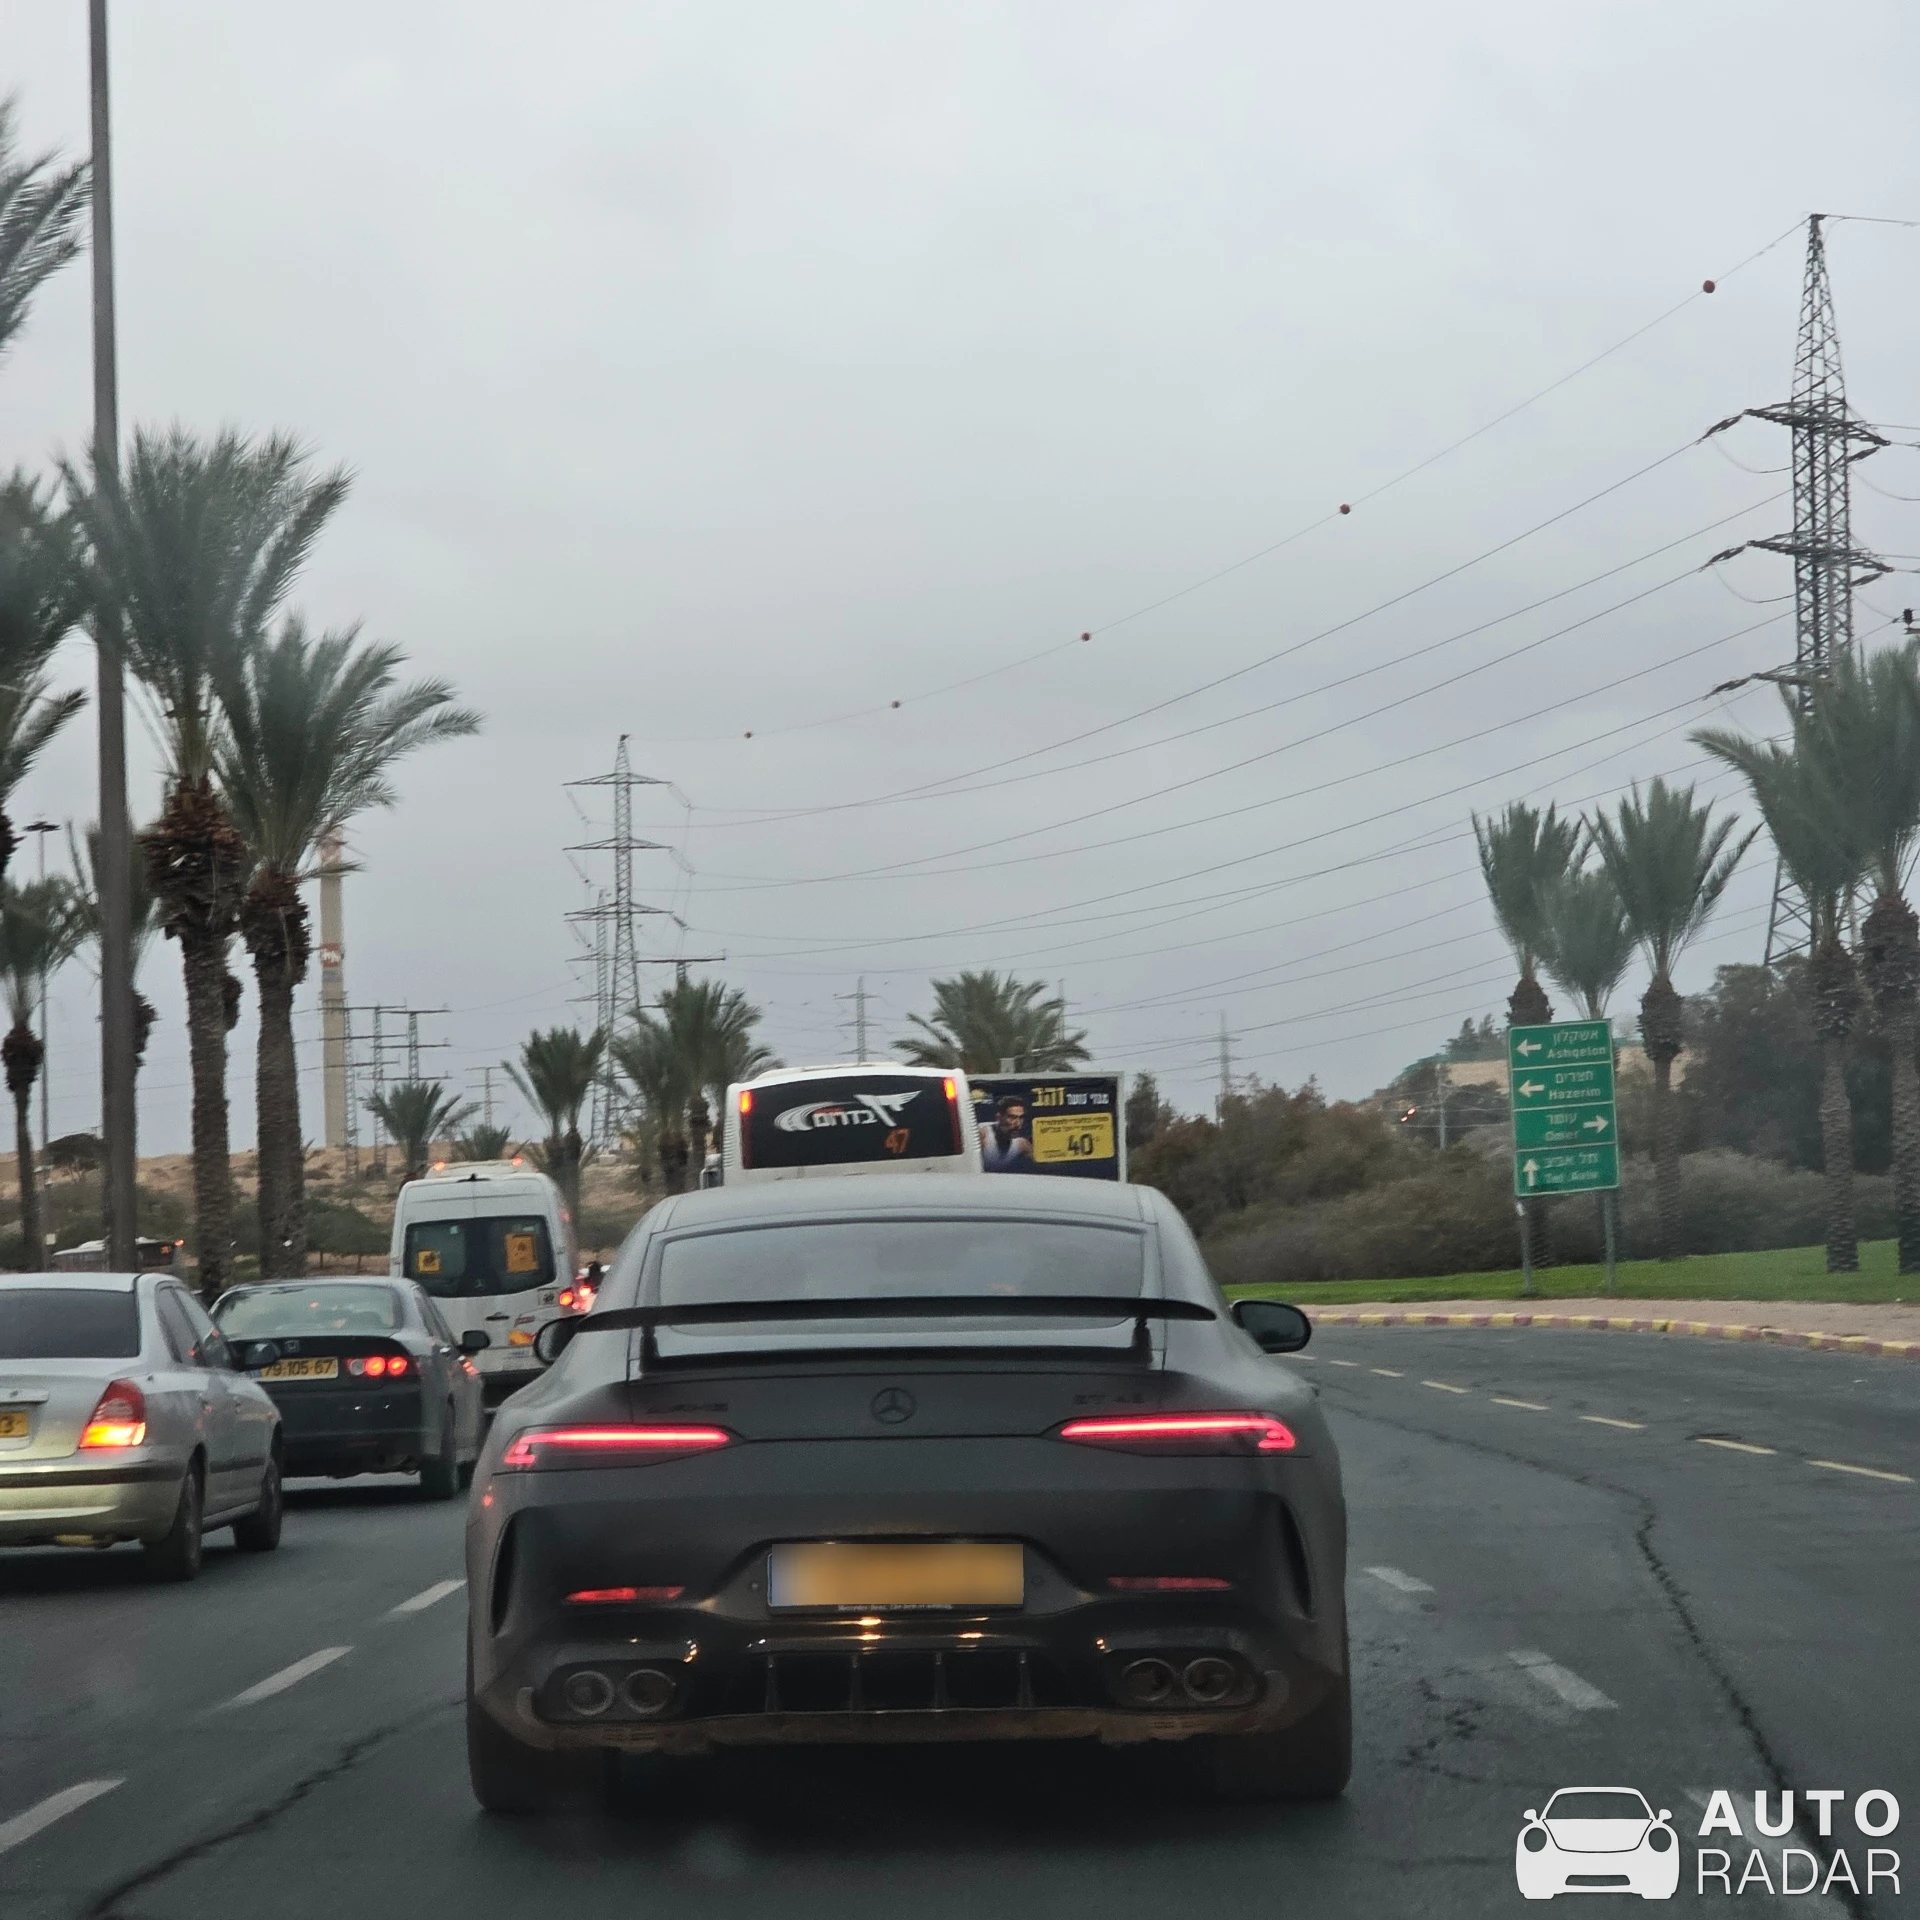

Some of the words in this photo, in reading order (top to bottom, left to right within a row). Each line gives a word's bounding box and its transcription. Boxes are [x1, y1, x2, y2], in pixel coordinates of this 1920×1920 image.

[1553, 1029, 1599, 1046] אשקלון
[1547, 1046, 1606, 1059] Ashqelon
[1555, 1070, 1594, 1084] חצרים
[1548, 1087, 1601, 1100] Hazerim
[1067, 1133, 1095, 1156] 40
